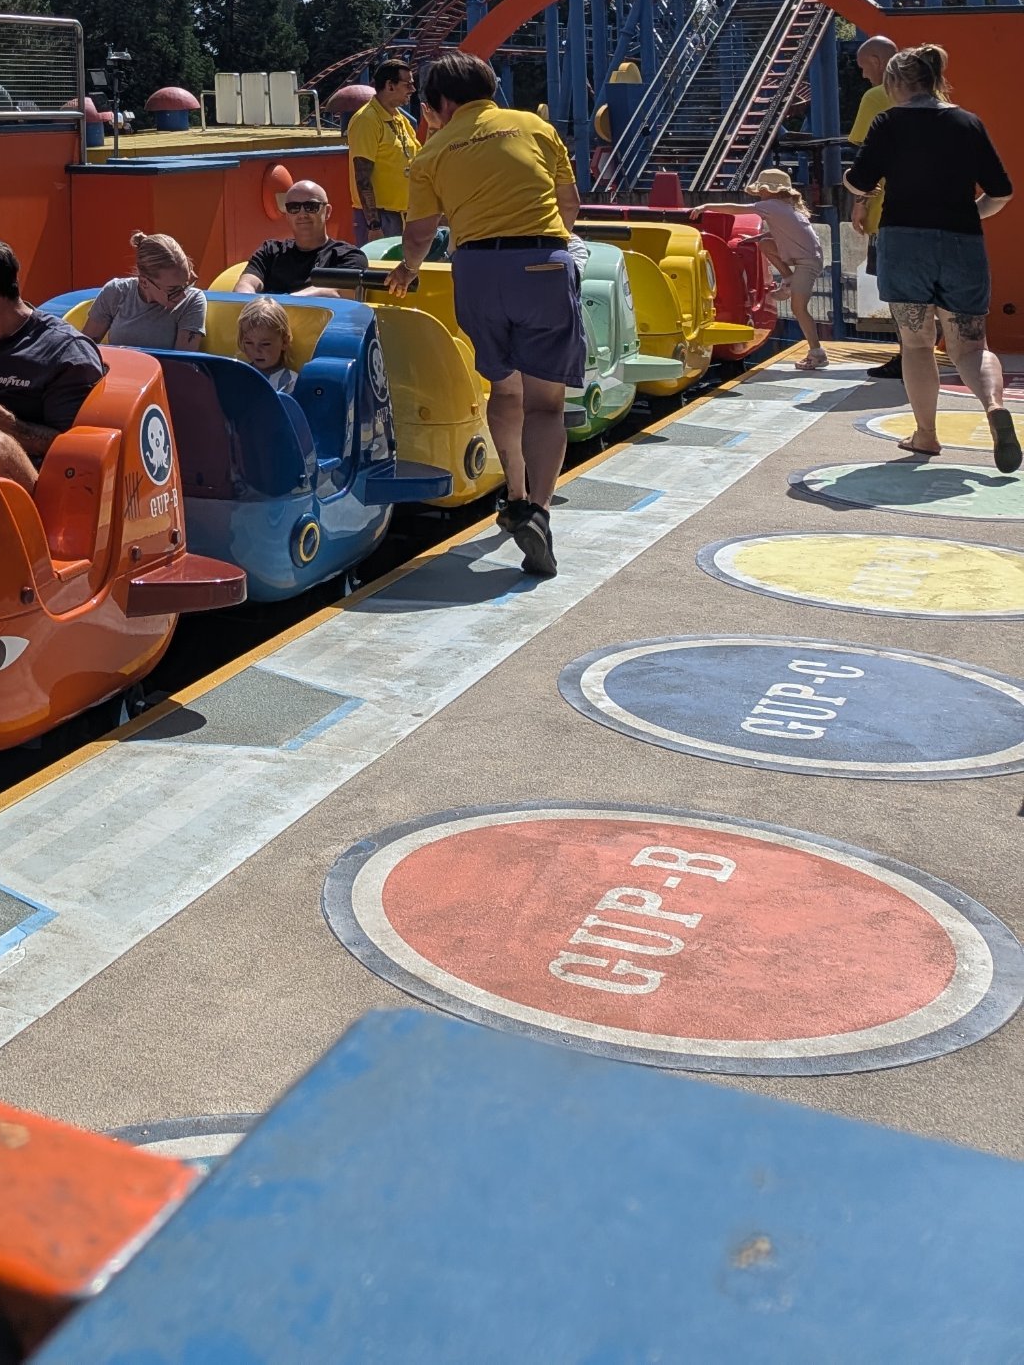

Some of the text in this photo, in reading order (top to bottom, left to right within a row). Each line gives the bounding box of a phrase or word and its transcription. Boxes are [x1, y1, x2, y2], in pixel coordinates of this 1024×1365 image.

[449, 141, 469, 152] Alton
[150, 487, 179, 518] GUP-B
[740, 659, 865, 740] GUP-C
[547, 845, 737, 995] GUP-B
